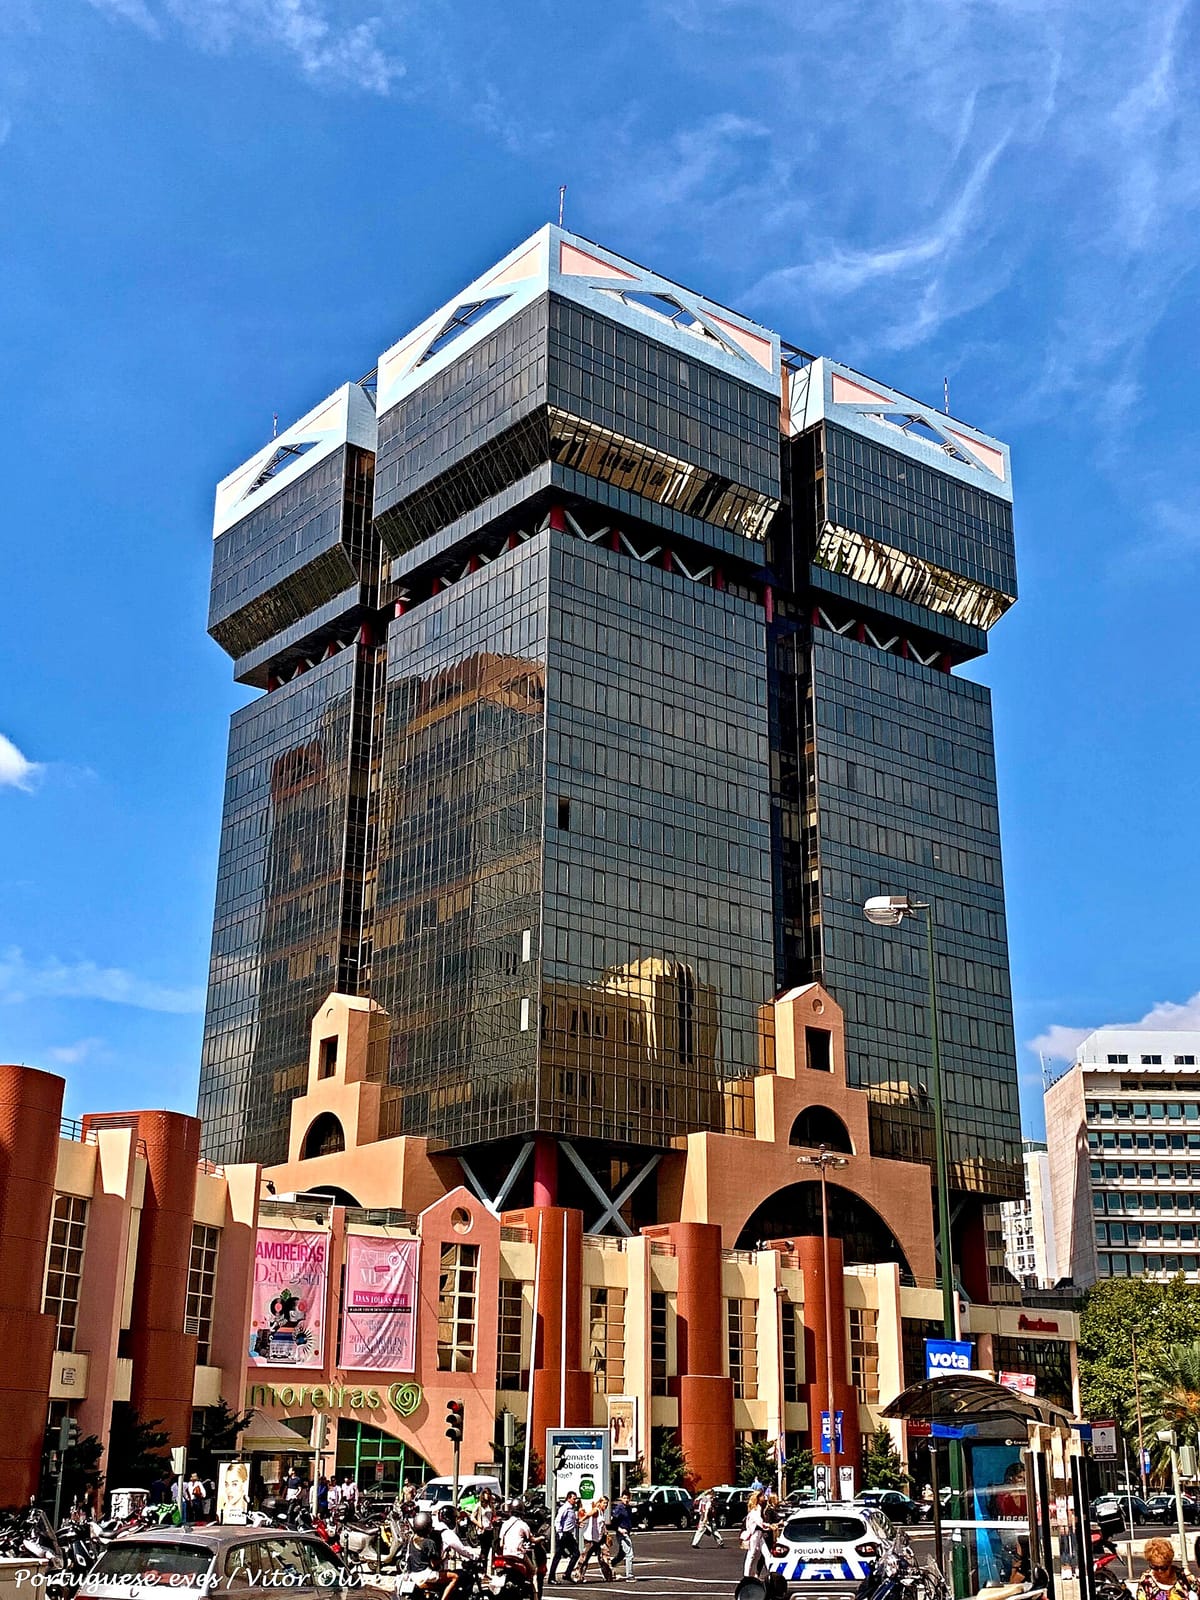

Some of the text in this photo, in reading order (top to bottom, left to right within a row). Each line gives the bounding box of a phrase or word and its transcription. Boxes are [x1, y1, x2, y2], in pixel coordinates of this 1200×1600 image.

[255, 1241, 324, 1263] AMOREIRAS
[255, 1262, 283, 1285] Day
[928, 1351, 969, 1369] vota
[246, 1383, 381, 1409] moreiras
[563, 1462, 599, 1470] obióticos
[564, 1453, 595, 1461] omaste
